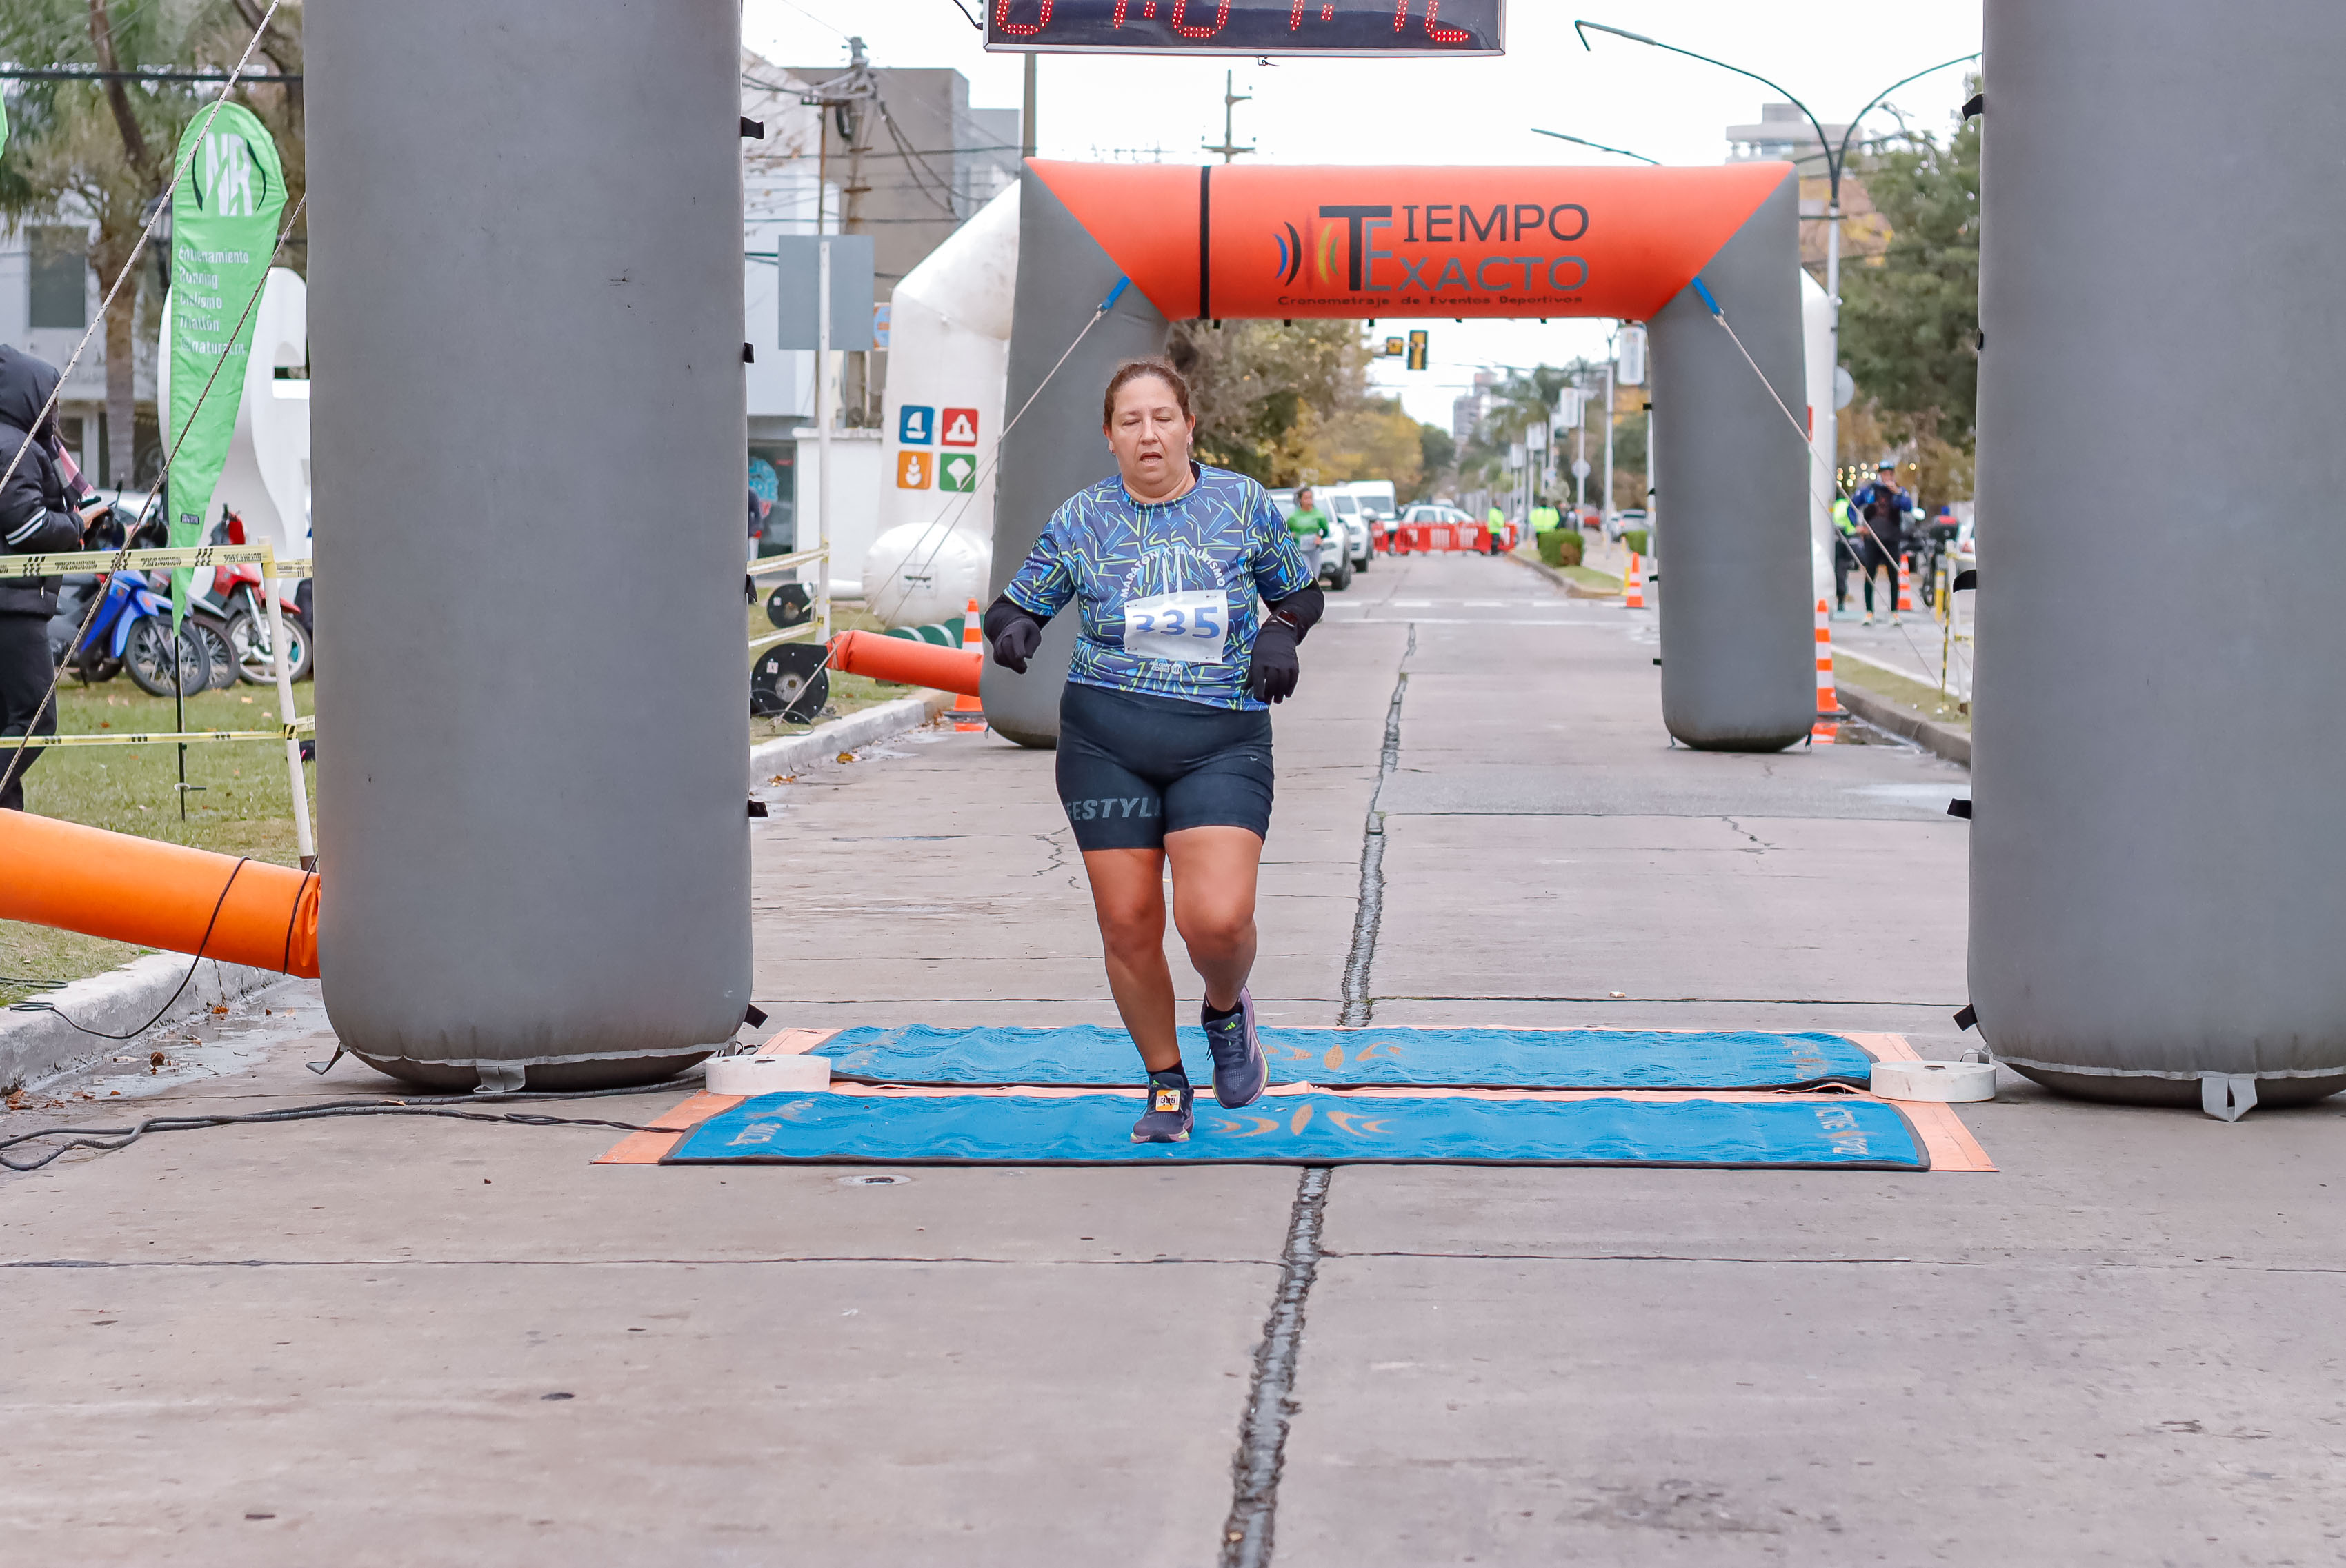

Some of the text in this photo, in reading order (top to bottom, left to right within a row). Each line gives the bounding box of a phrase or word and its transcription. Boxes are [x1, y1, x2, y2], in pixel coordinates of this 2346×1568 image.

[1319, 204, 1589, 291] TIEMPO
[1364, 220, 1589, 291] EXACTO
[178, 266, 219, 290] Running
[1278, 295, 1390, 308] Cronometraje
[1429, 295, 1491, 304] Eventos
[1499, 295, 1583, 306] Deportivos
[1189, 547, 1226, 587] AUTISMO
[1132, 606, 1220, 639] 335
